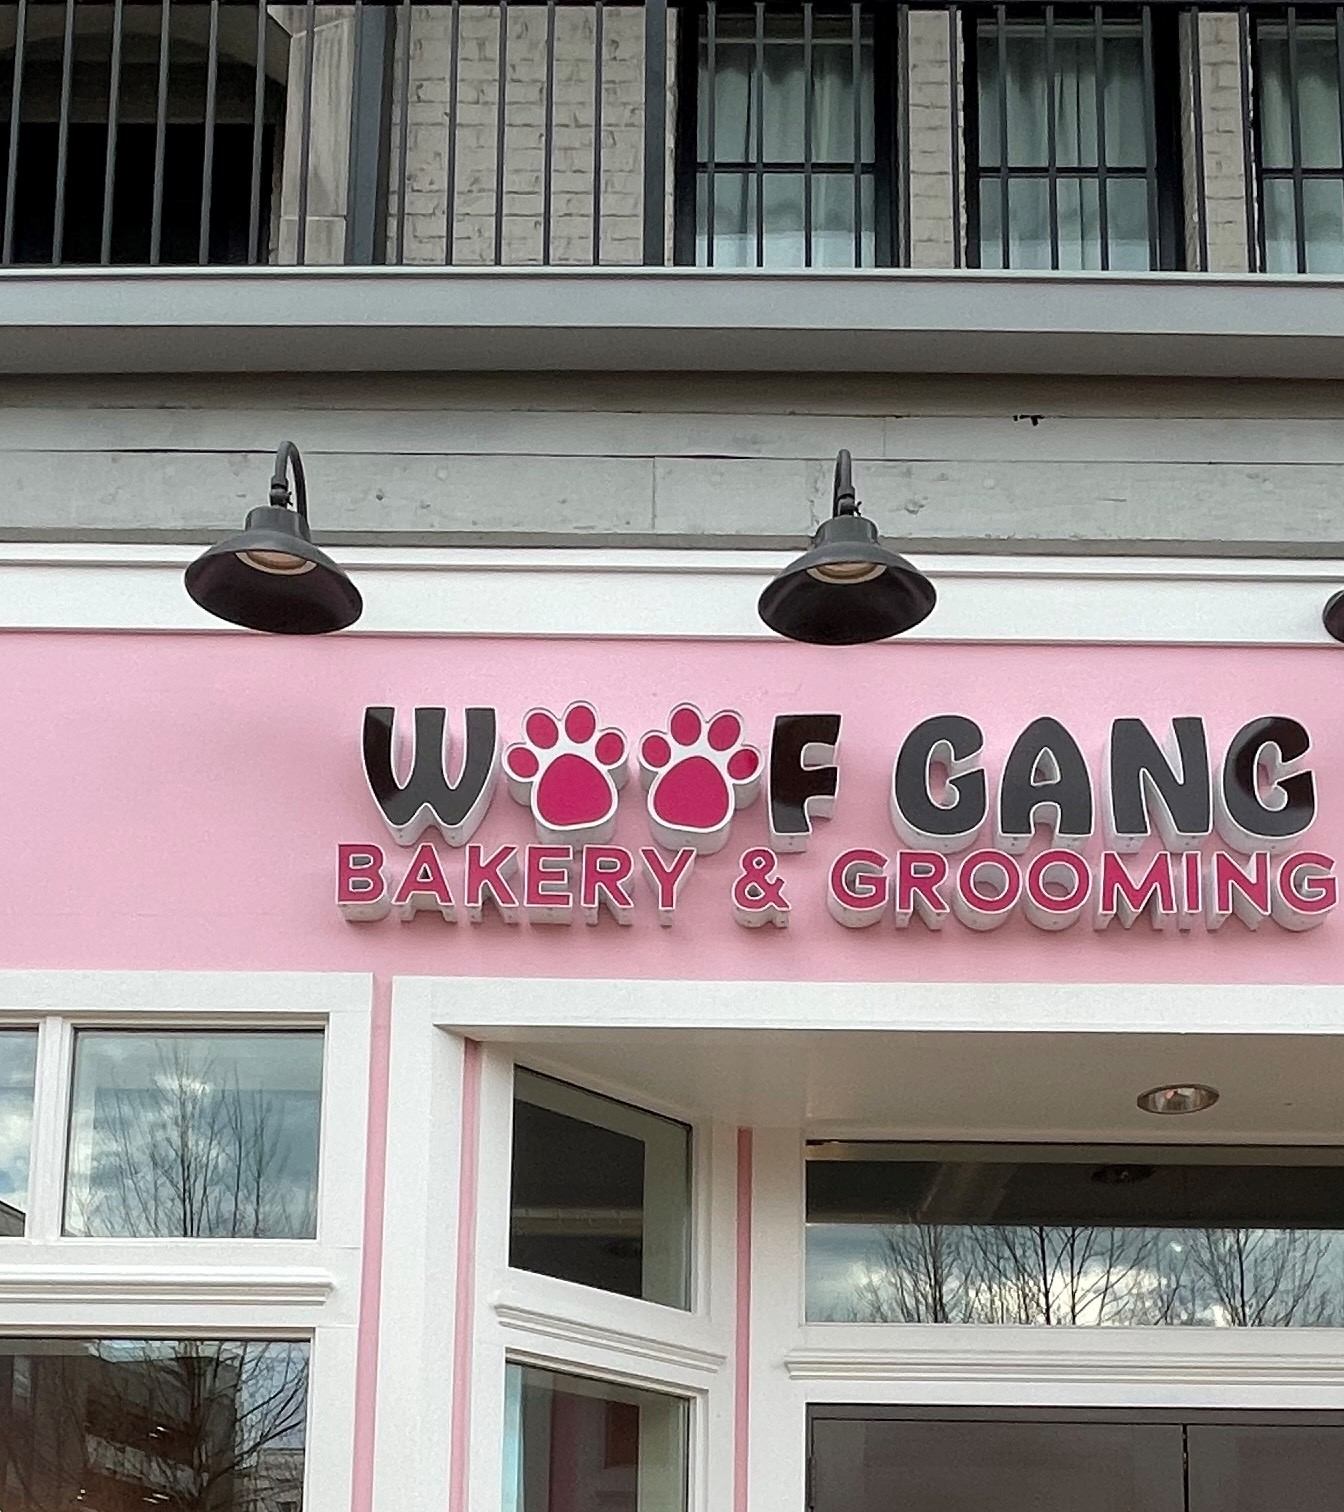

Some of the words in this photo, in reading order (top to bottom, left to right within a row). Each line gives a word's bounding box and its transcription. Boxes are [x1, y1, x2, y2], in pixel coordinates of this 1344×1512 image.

[892, 713, 1319, 840] GANG
[335, 841, 698, 914] BAKERY
[732, 853, 793, 914] &
[828, 848, 1340, 915] GROOMING
